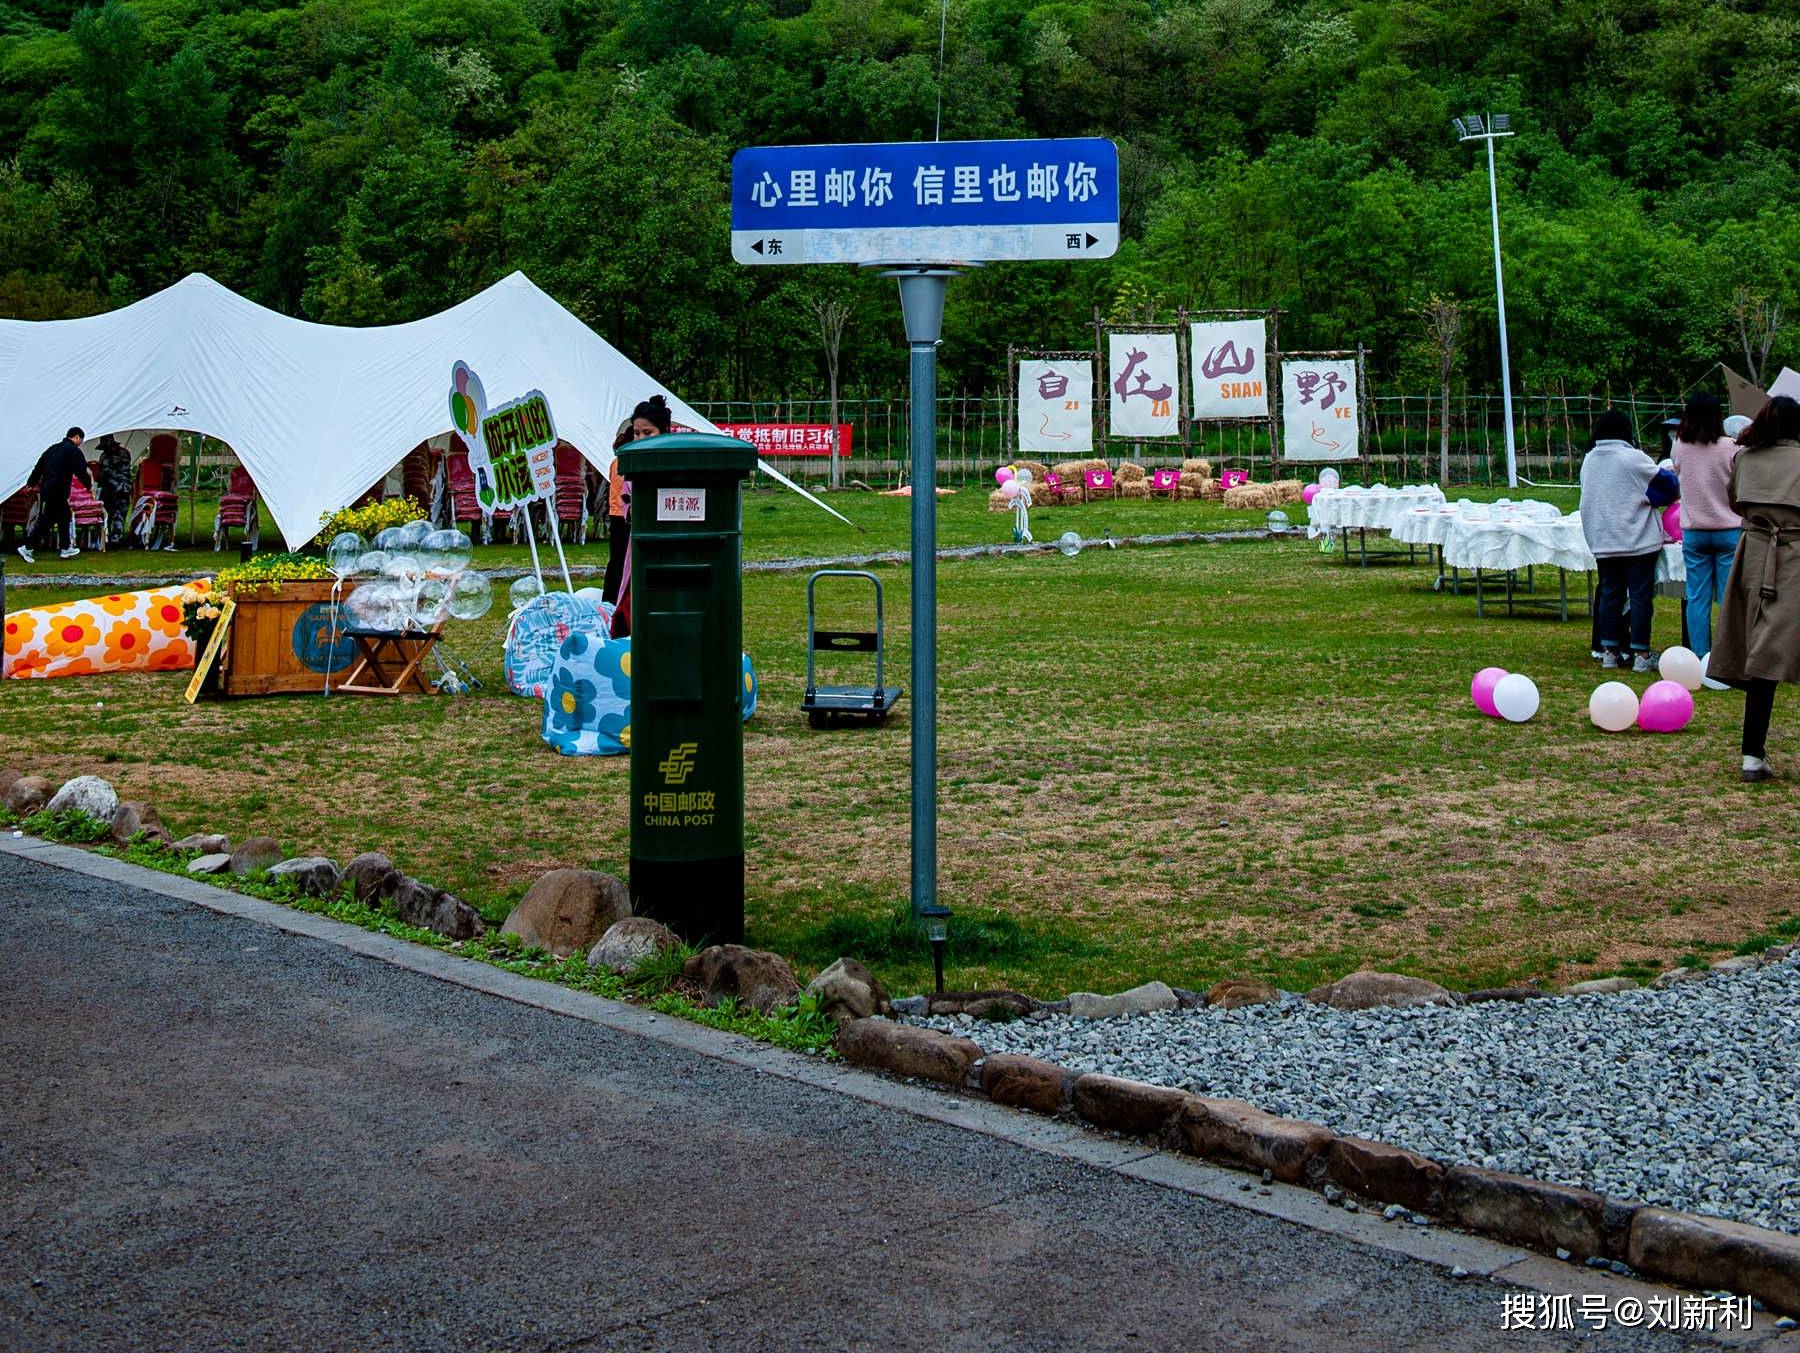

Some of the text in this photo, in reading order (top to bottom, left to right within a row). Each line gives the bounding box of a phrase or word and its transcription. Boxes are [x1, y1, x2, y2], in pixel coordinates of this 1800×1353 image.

[751, 161, 1099, 209] 心里邮你 信里也邮你
[767, 239, 783, 256] 东
[1065, 233, 1082, 250] 西
[1202, 340, 1255, 379] 山
[1037, 370, 1069, 400] 自
[1114, 347, 1172, 403] 在
[1220, 380, 1263, 400] SHAN
[1295, 371, 1347, 410] 野
[1064, 400, 1080, 411] ZI
[1335, 407, 1352, 419] YE
[643, 791, 717, 813] 中国邮政
[644, 813, 716, 827] CHINA POST
